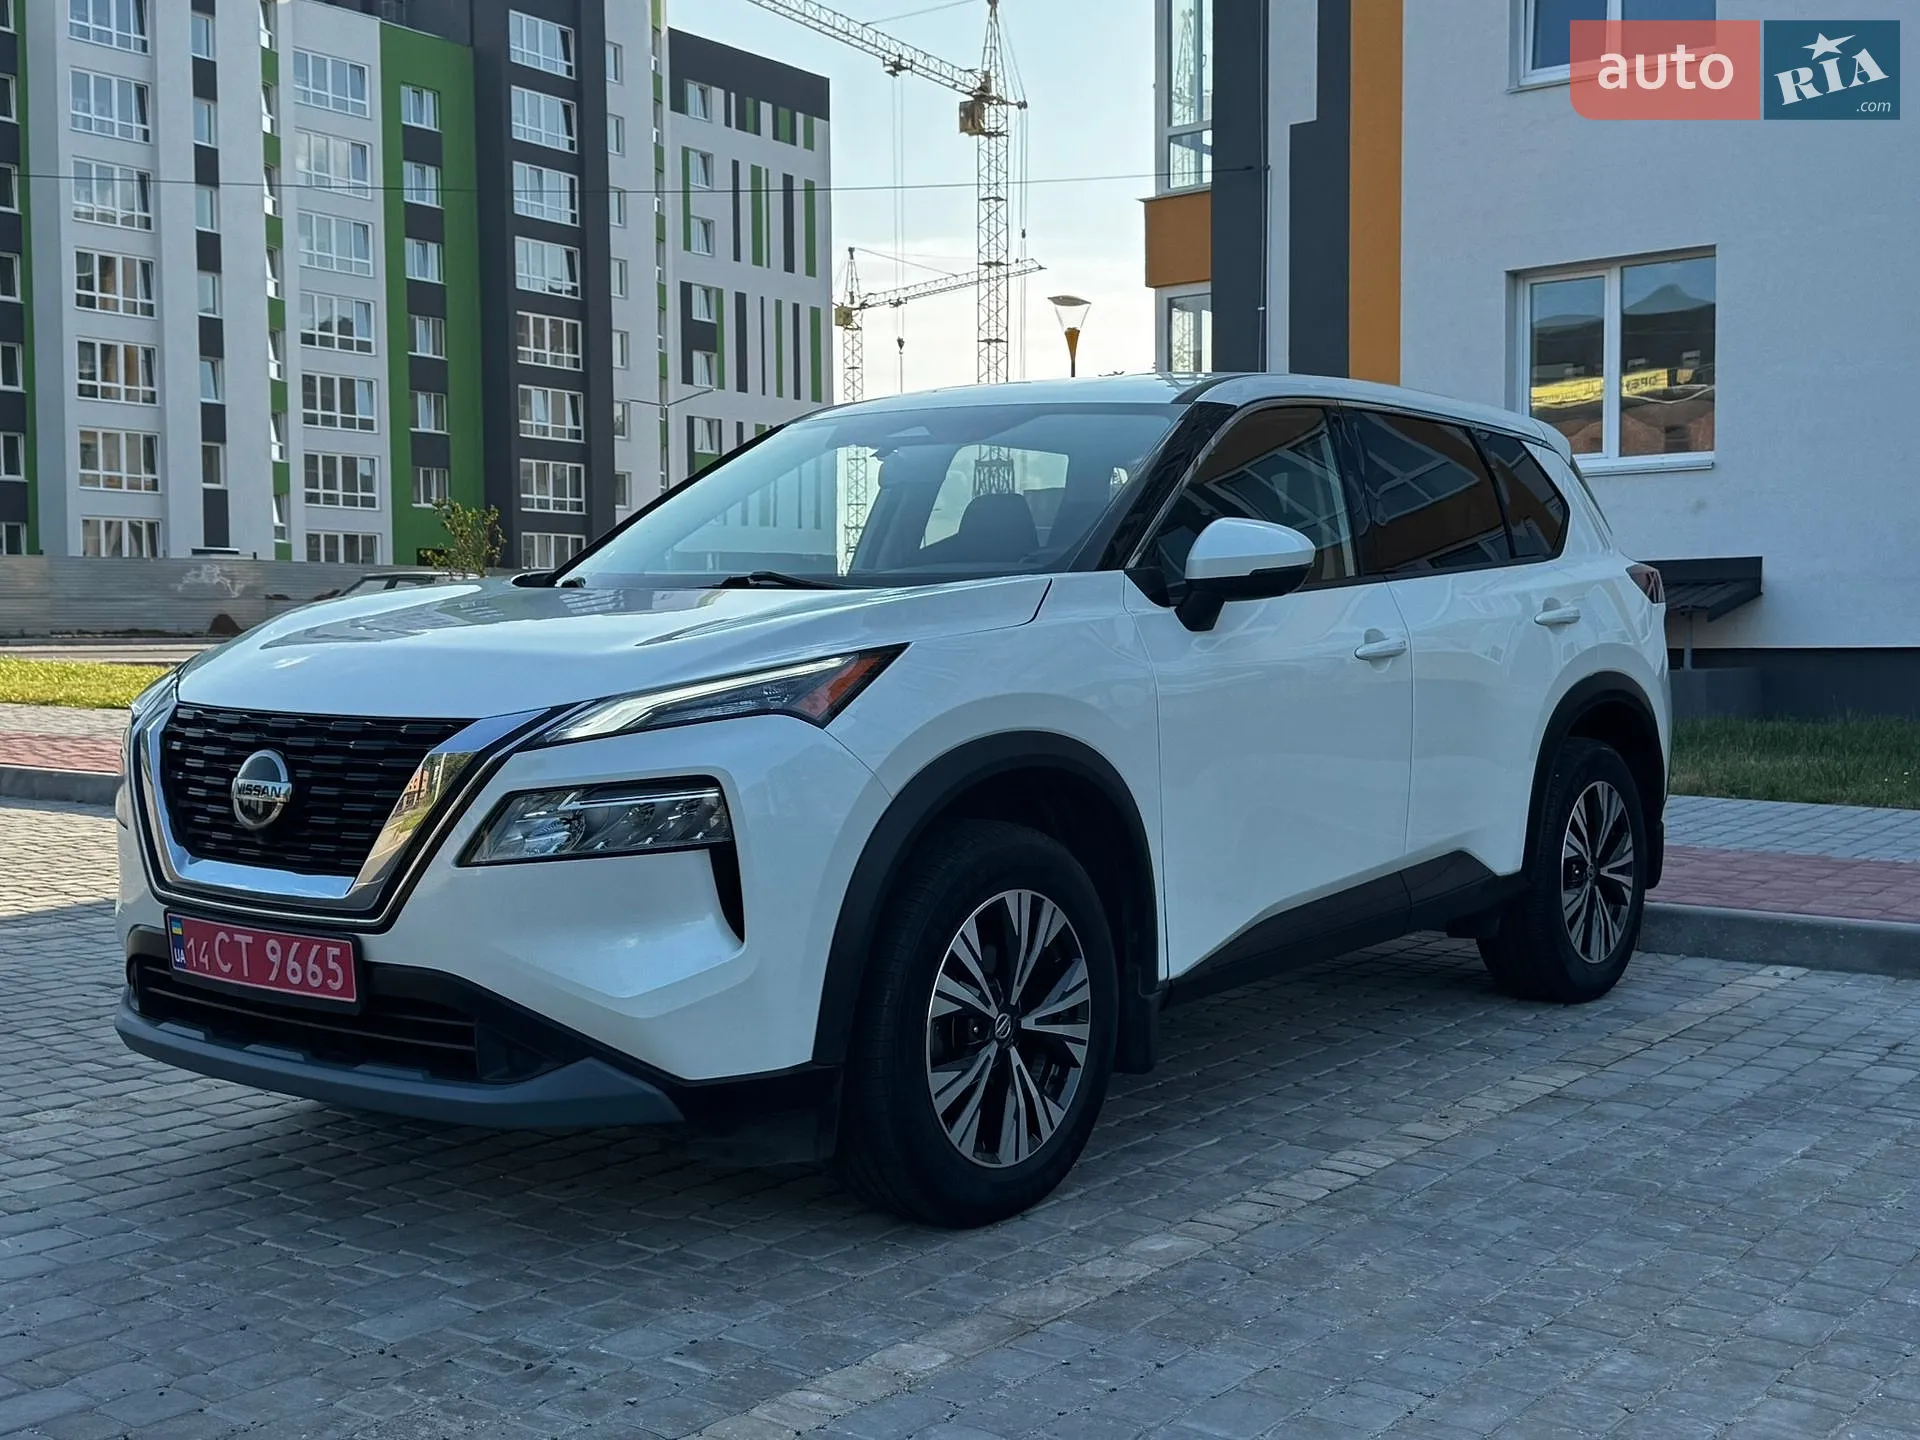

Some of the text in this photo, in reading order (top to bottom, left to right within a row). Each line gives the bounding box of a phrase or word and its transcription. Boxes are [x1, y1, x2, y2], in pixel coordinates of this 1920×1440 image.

[237, 783, 282, 798] NISSAN
[174, 947, 187, 964] UA
[265, 939, 344, 991] 9665
